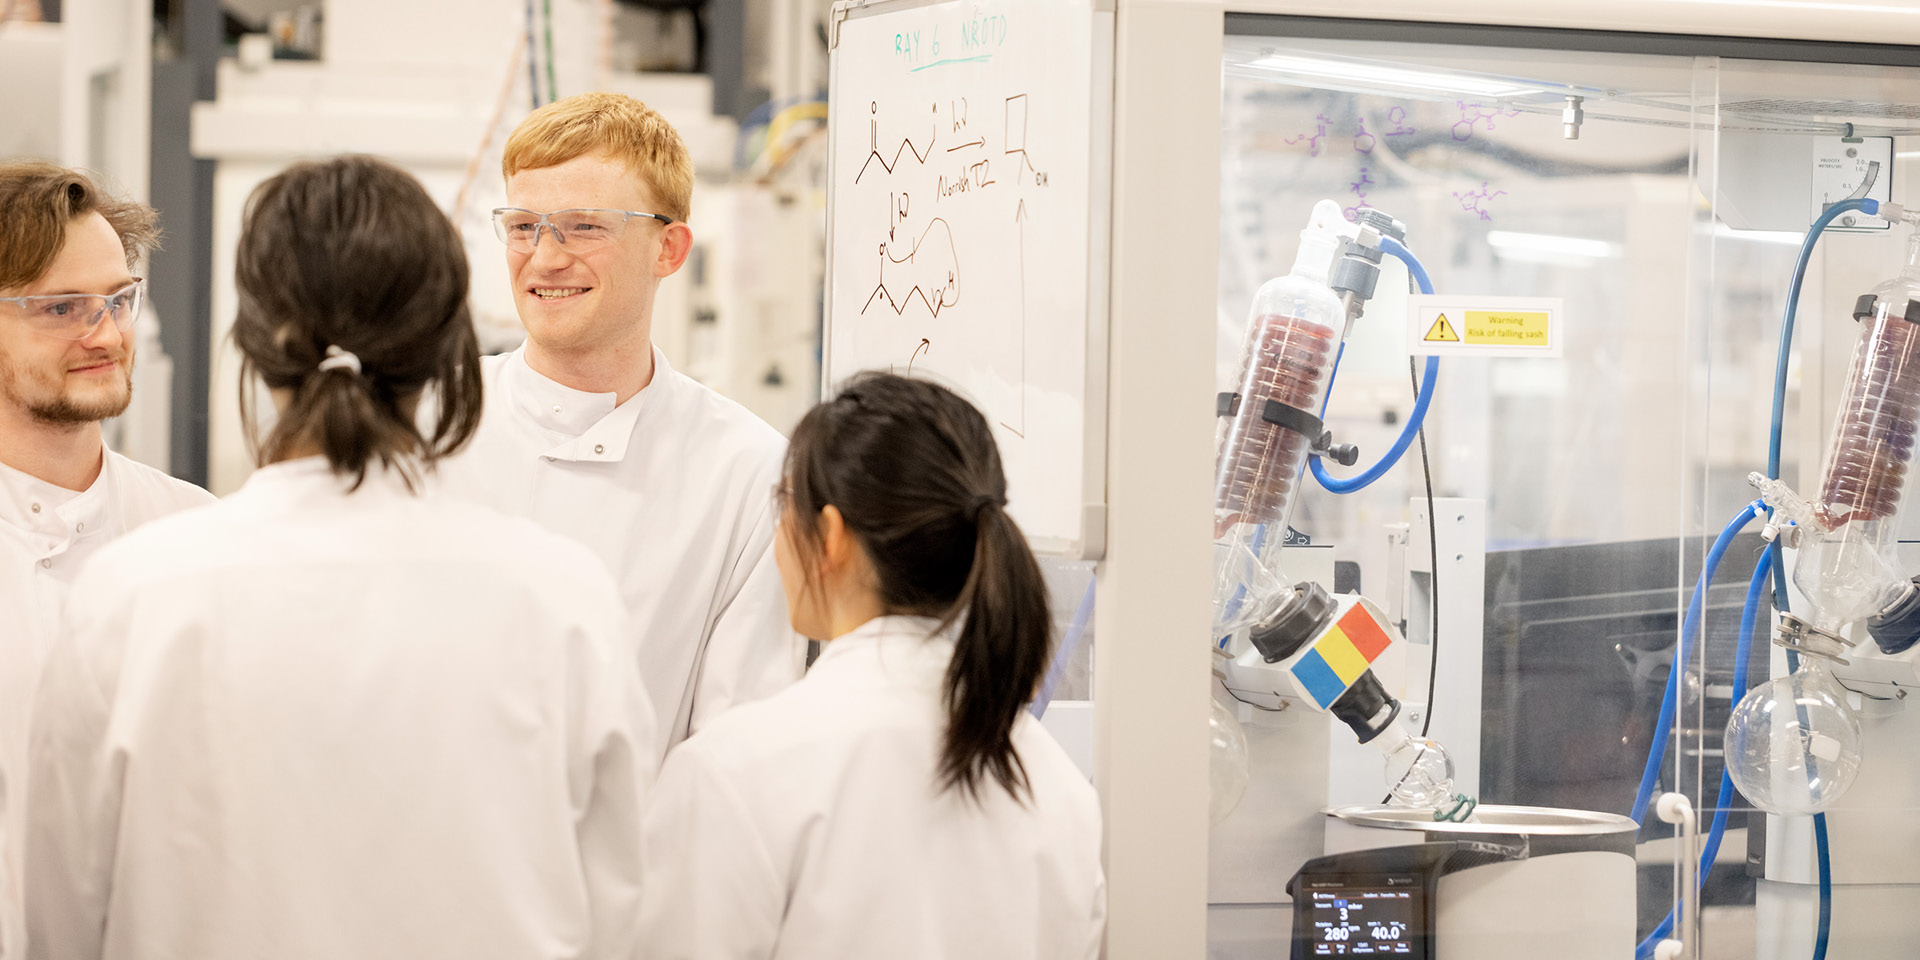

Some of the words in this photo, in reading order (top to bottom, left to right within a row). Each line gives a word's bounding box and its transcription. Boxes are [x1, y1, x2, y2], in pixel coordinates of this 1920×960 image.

[931, 24, 940, 56] 6
[1488, 316, 1524, 326] Warning
[1467, 329, 1485, 337] Risk
[1497, 329, 1524, 339] falling
[1525, 330, 1544, 338] sash
[1339, 907, 1349, 921] 3
[1324, 927, 1350, 941] 280
[1371, 926, 1400, 940] 40.0
